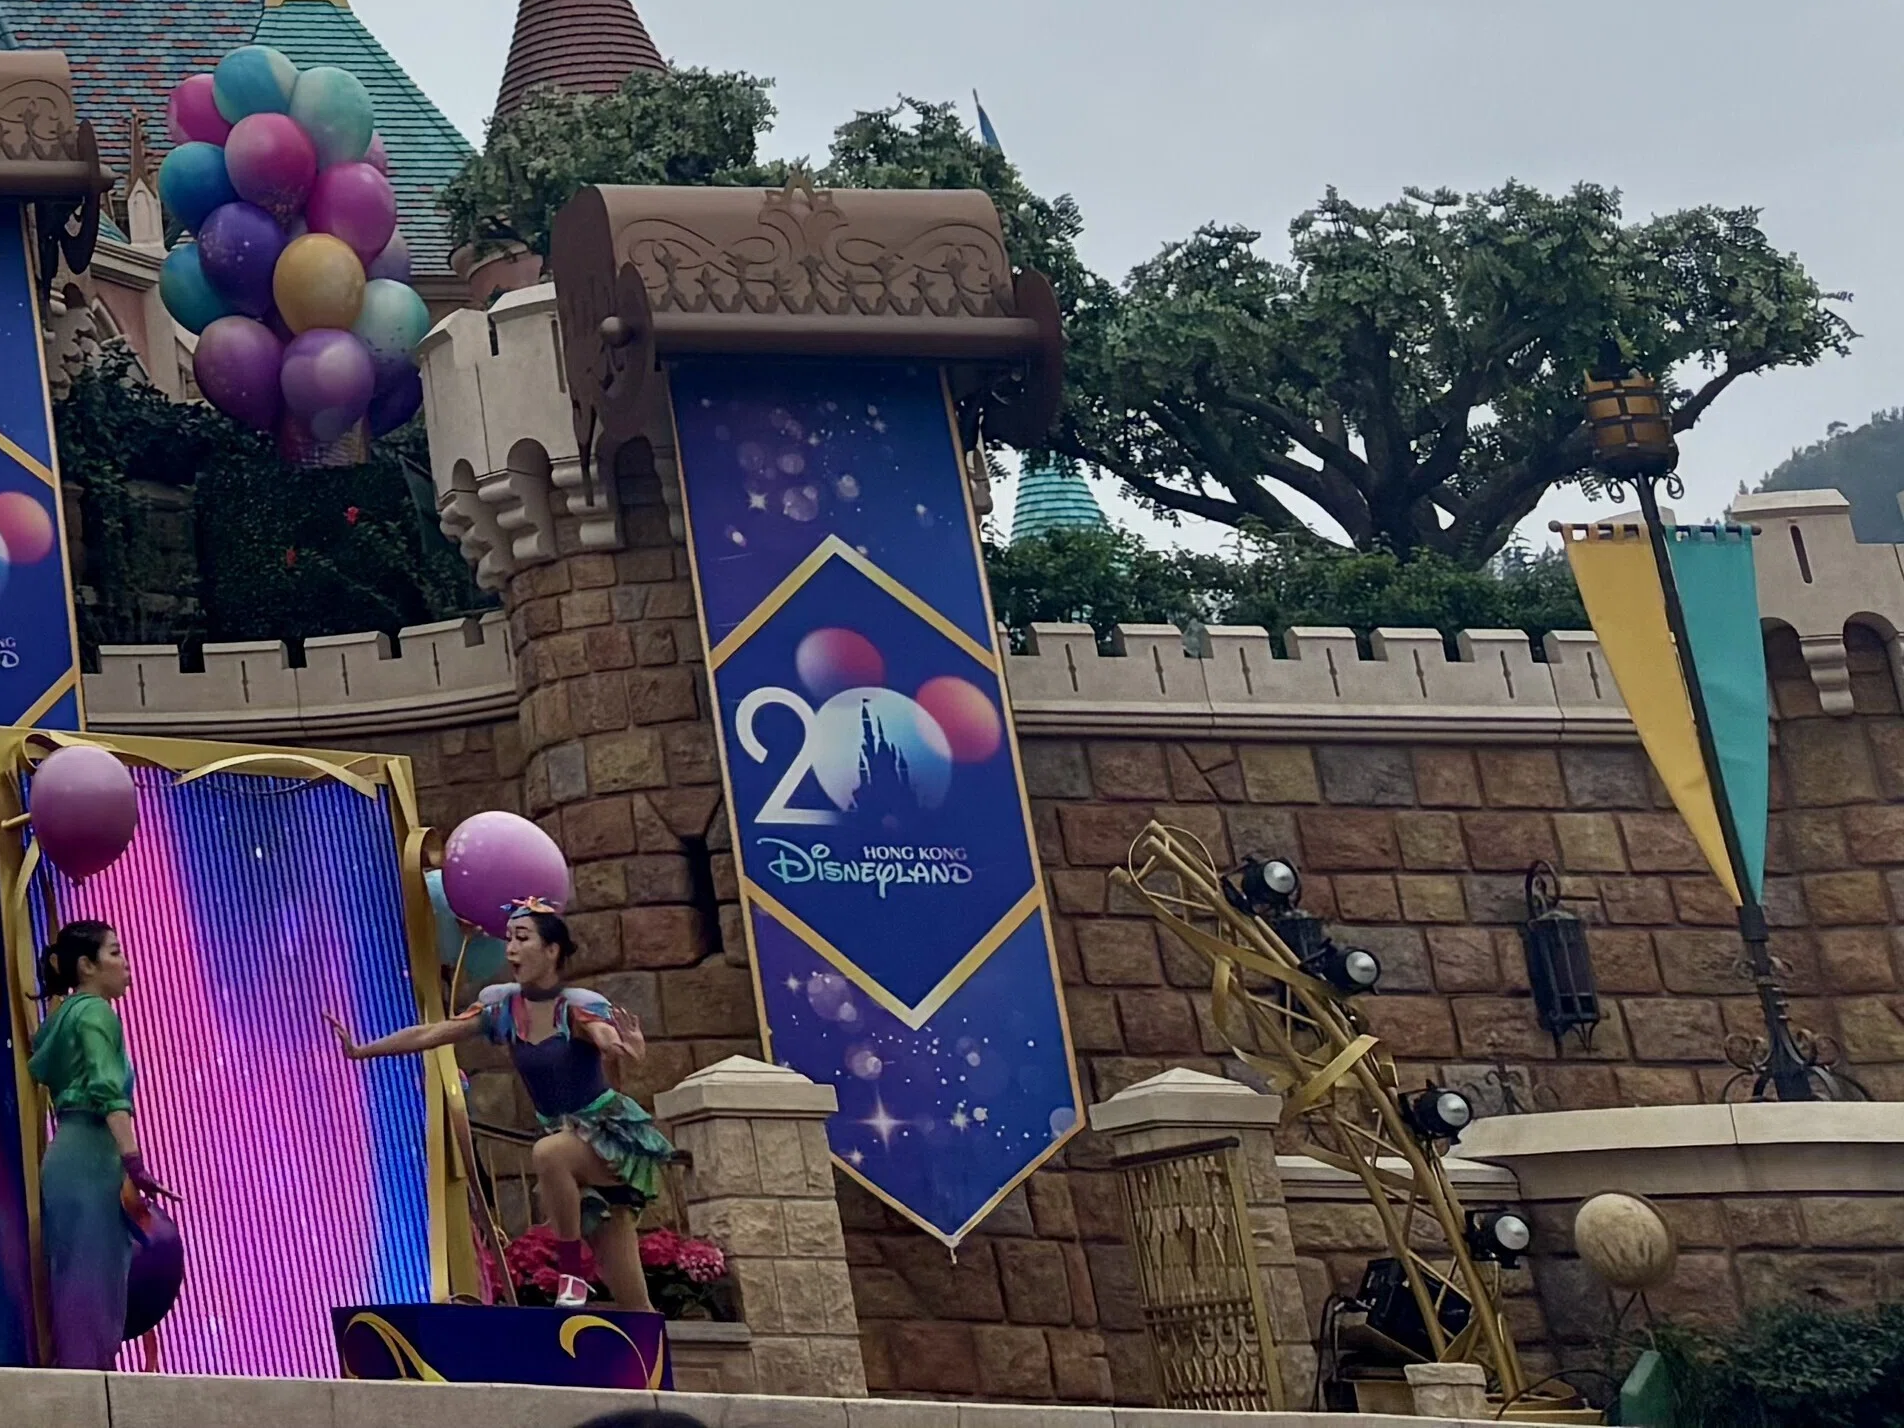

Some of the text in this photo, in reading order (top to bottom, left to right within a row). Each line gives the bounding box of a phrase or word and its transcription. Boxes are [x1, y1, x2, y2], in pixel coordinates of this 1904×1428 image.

[735, 686, 953, 826] 20
[863, 845, 968, 861] HONG KONG
